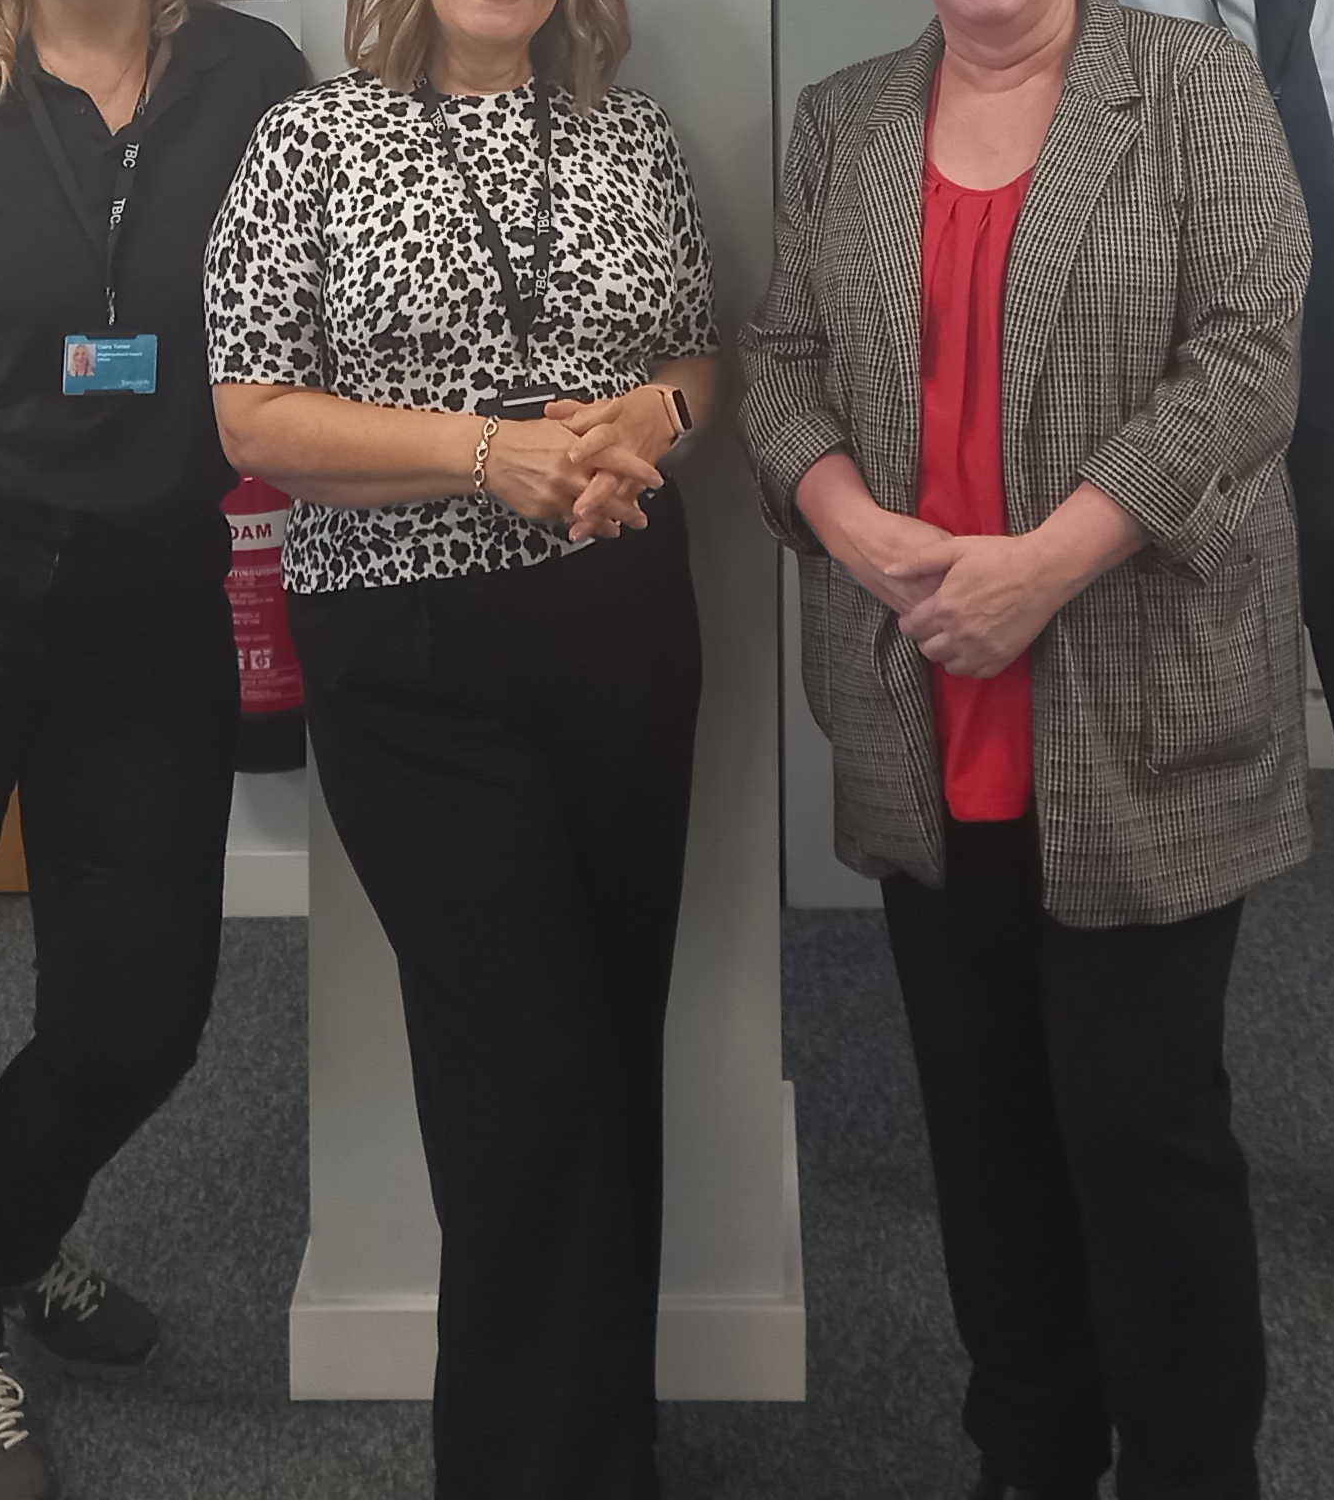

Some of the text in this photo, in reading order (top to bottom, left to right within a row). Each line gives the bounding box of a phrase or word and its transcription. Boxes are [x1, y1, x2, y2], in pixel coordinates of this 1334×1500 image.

[430, 107, 446, 135] TBC
[122, 143, 140, 169] TBC
[109, 197, 126, 225] TBC
[536, 209, 550, 236] TBC
[534, 268, 548, 297] TBC
[229, 523, 273, 541] OAM
